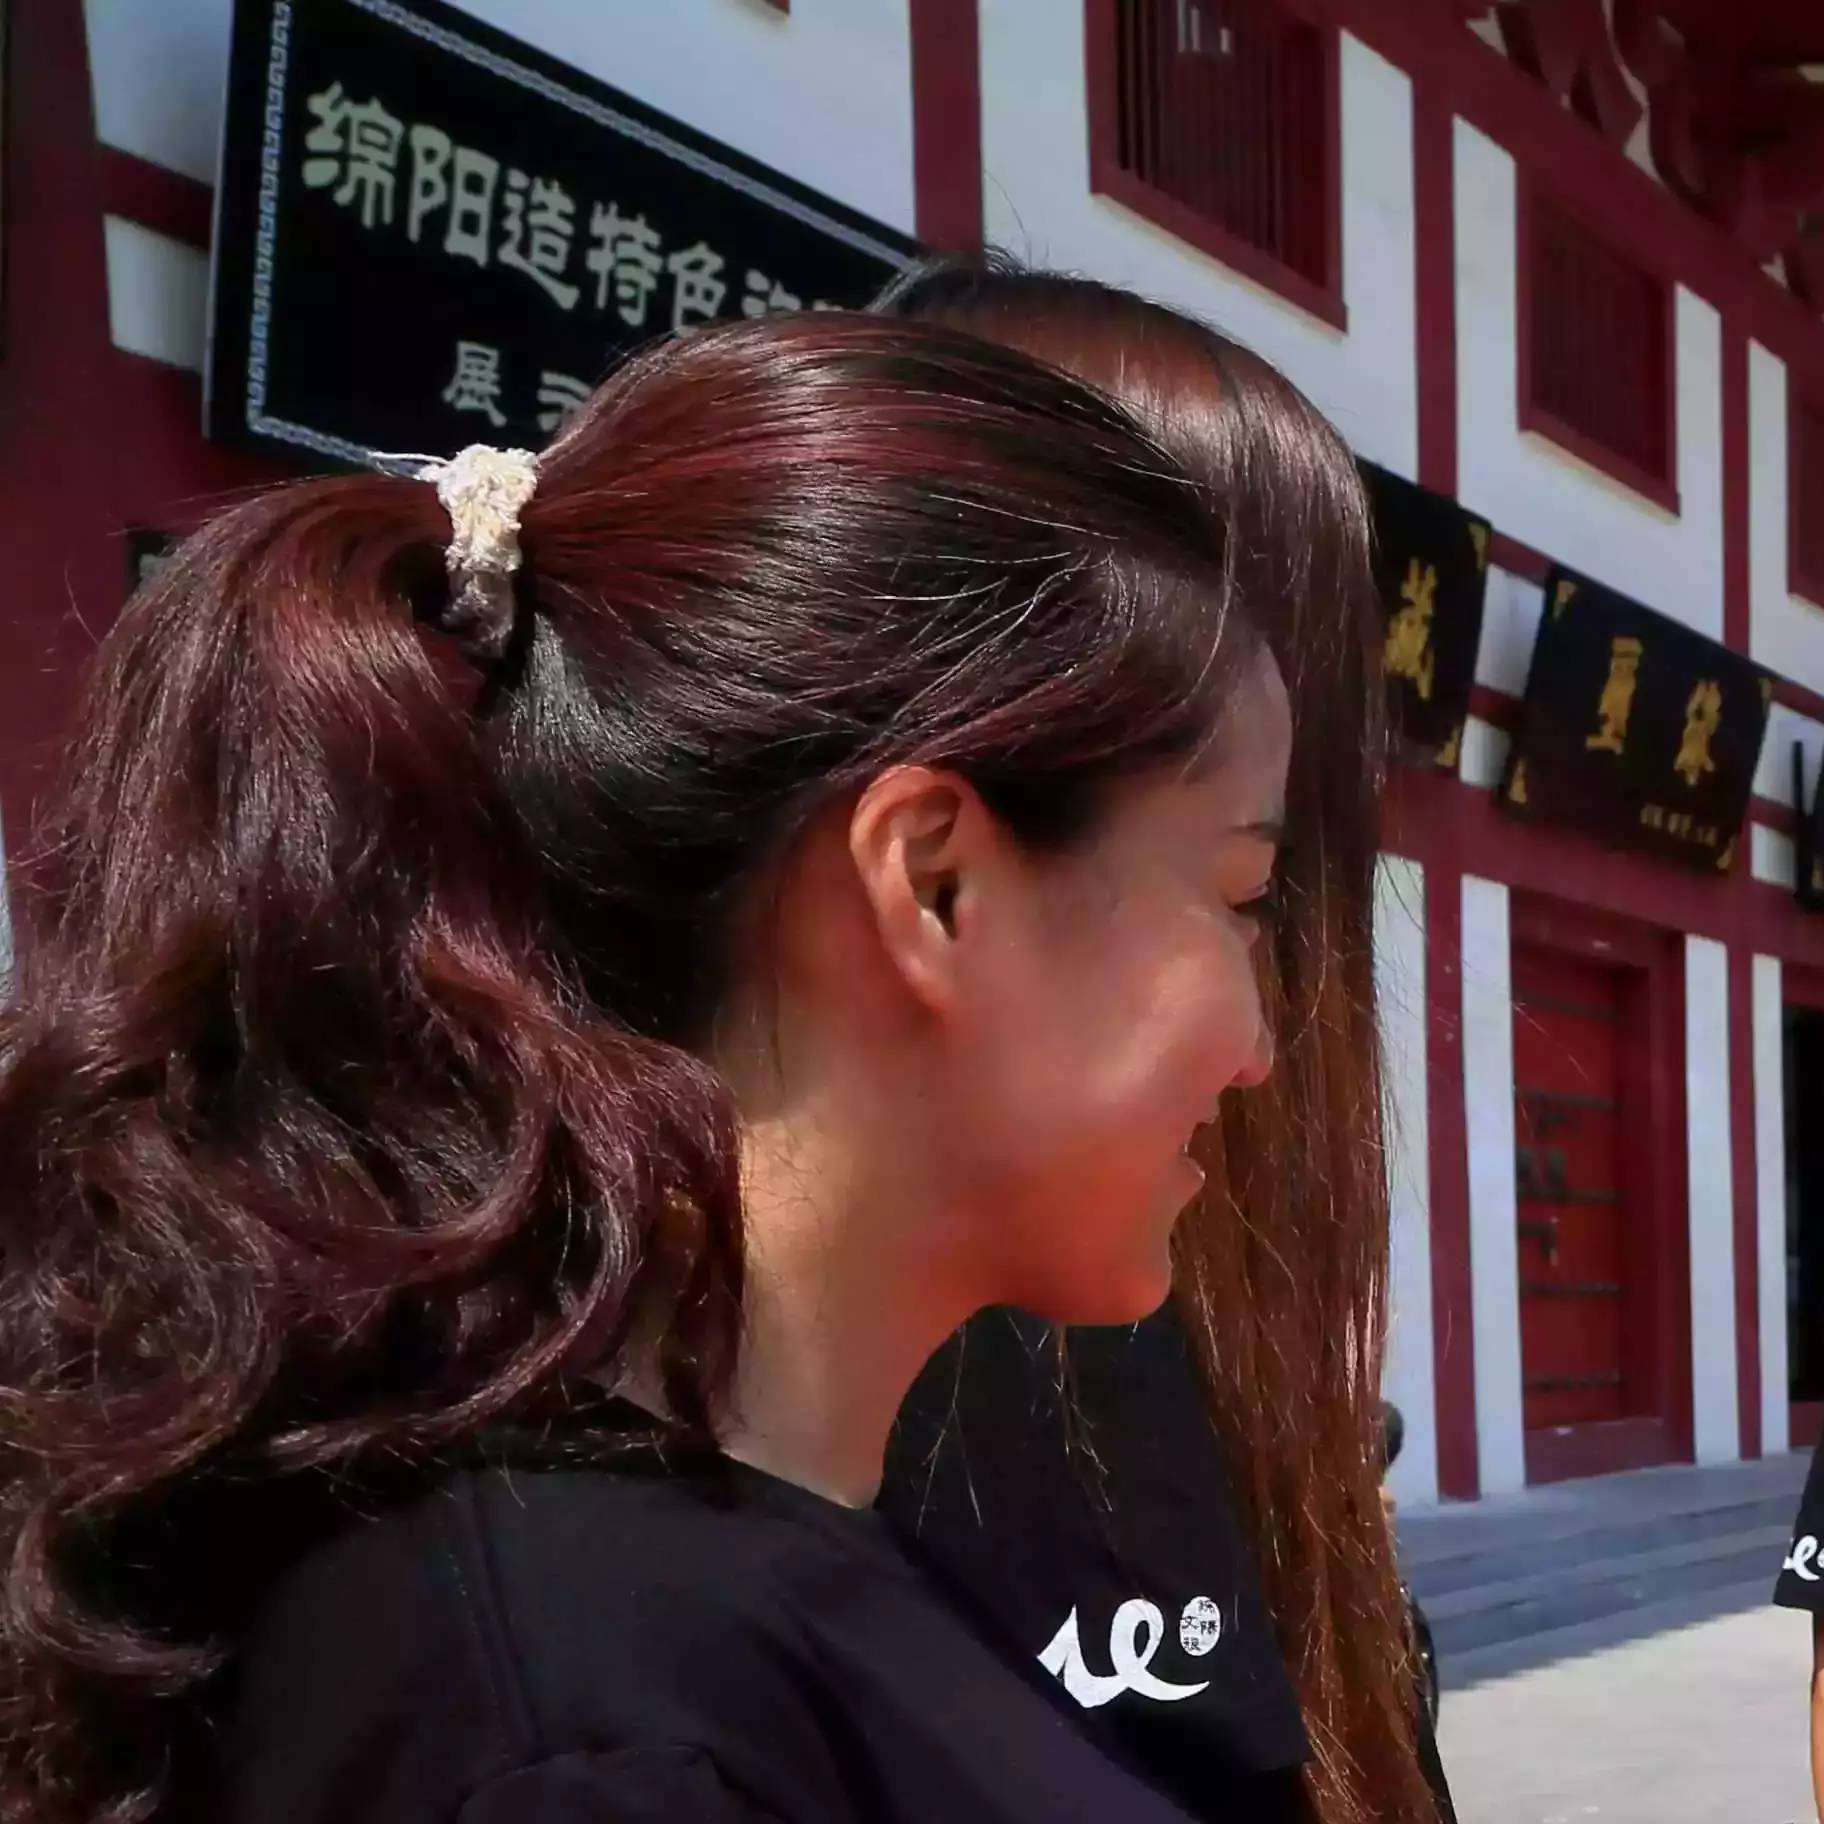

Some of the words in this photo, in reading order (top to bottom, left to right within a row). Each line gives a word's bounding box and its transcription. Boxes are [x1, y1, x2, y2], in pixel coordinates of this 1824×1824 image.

[302, 80, 843, 336] 绵阳造特色
